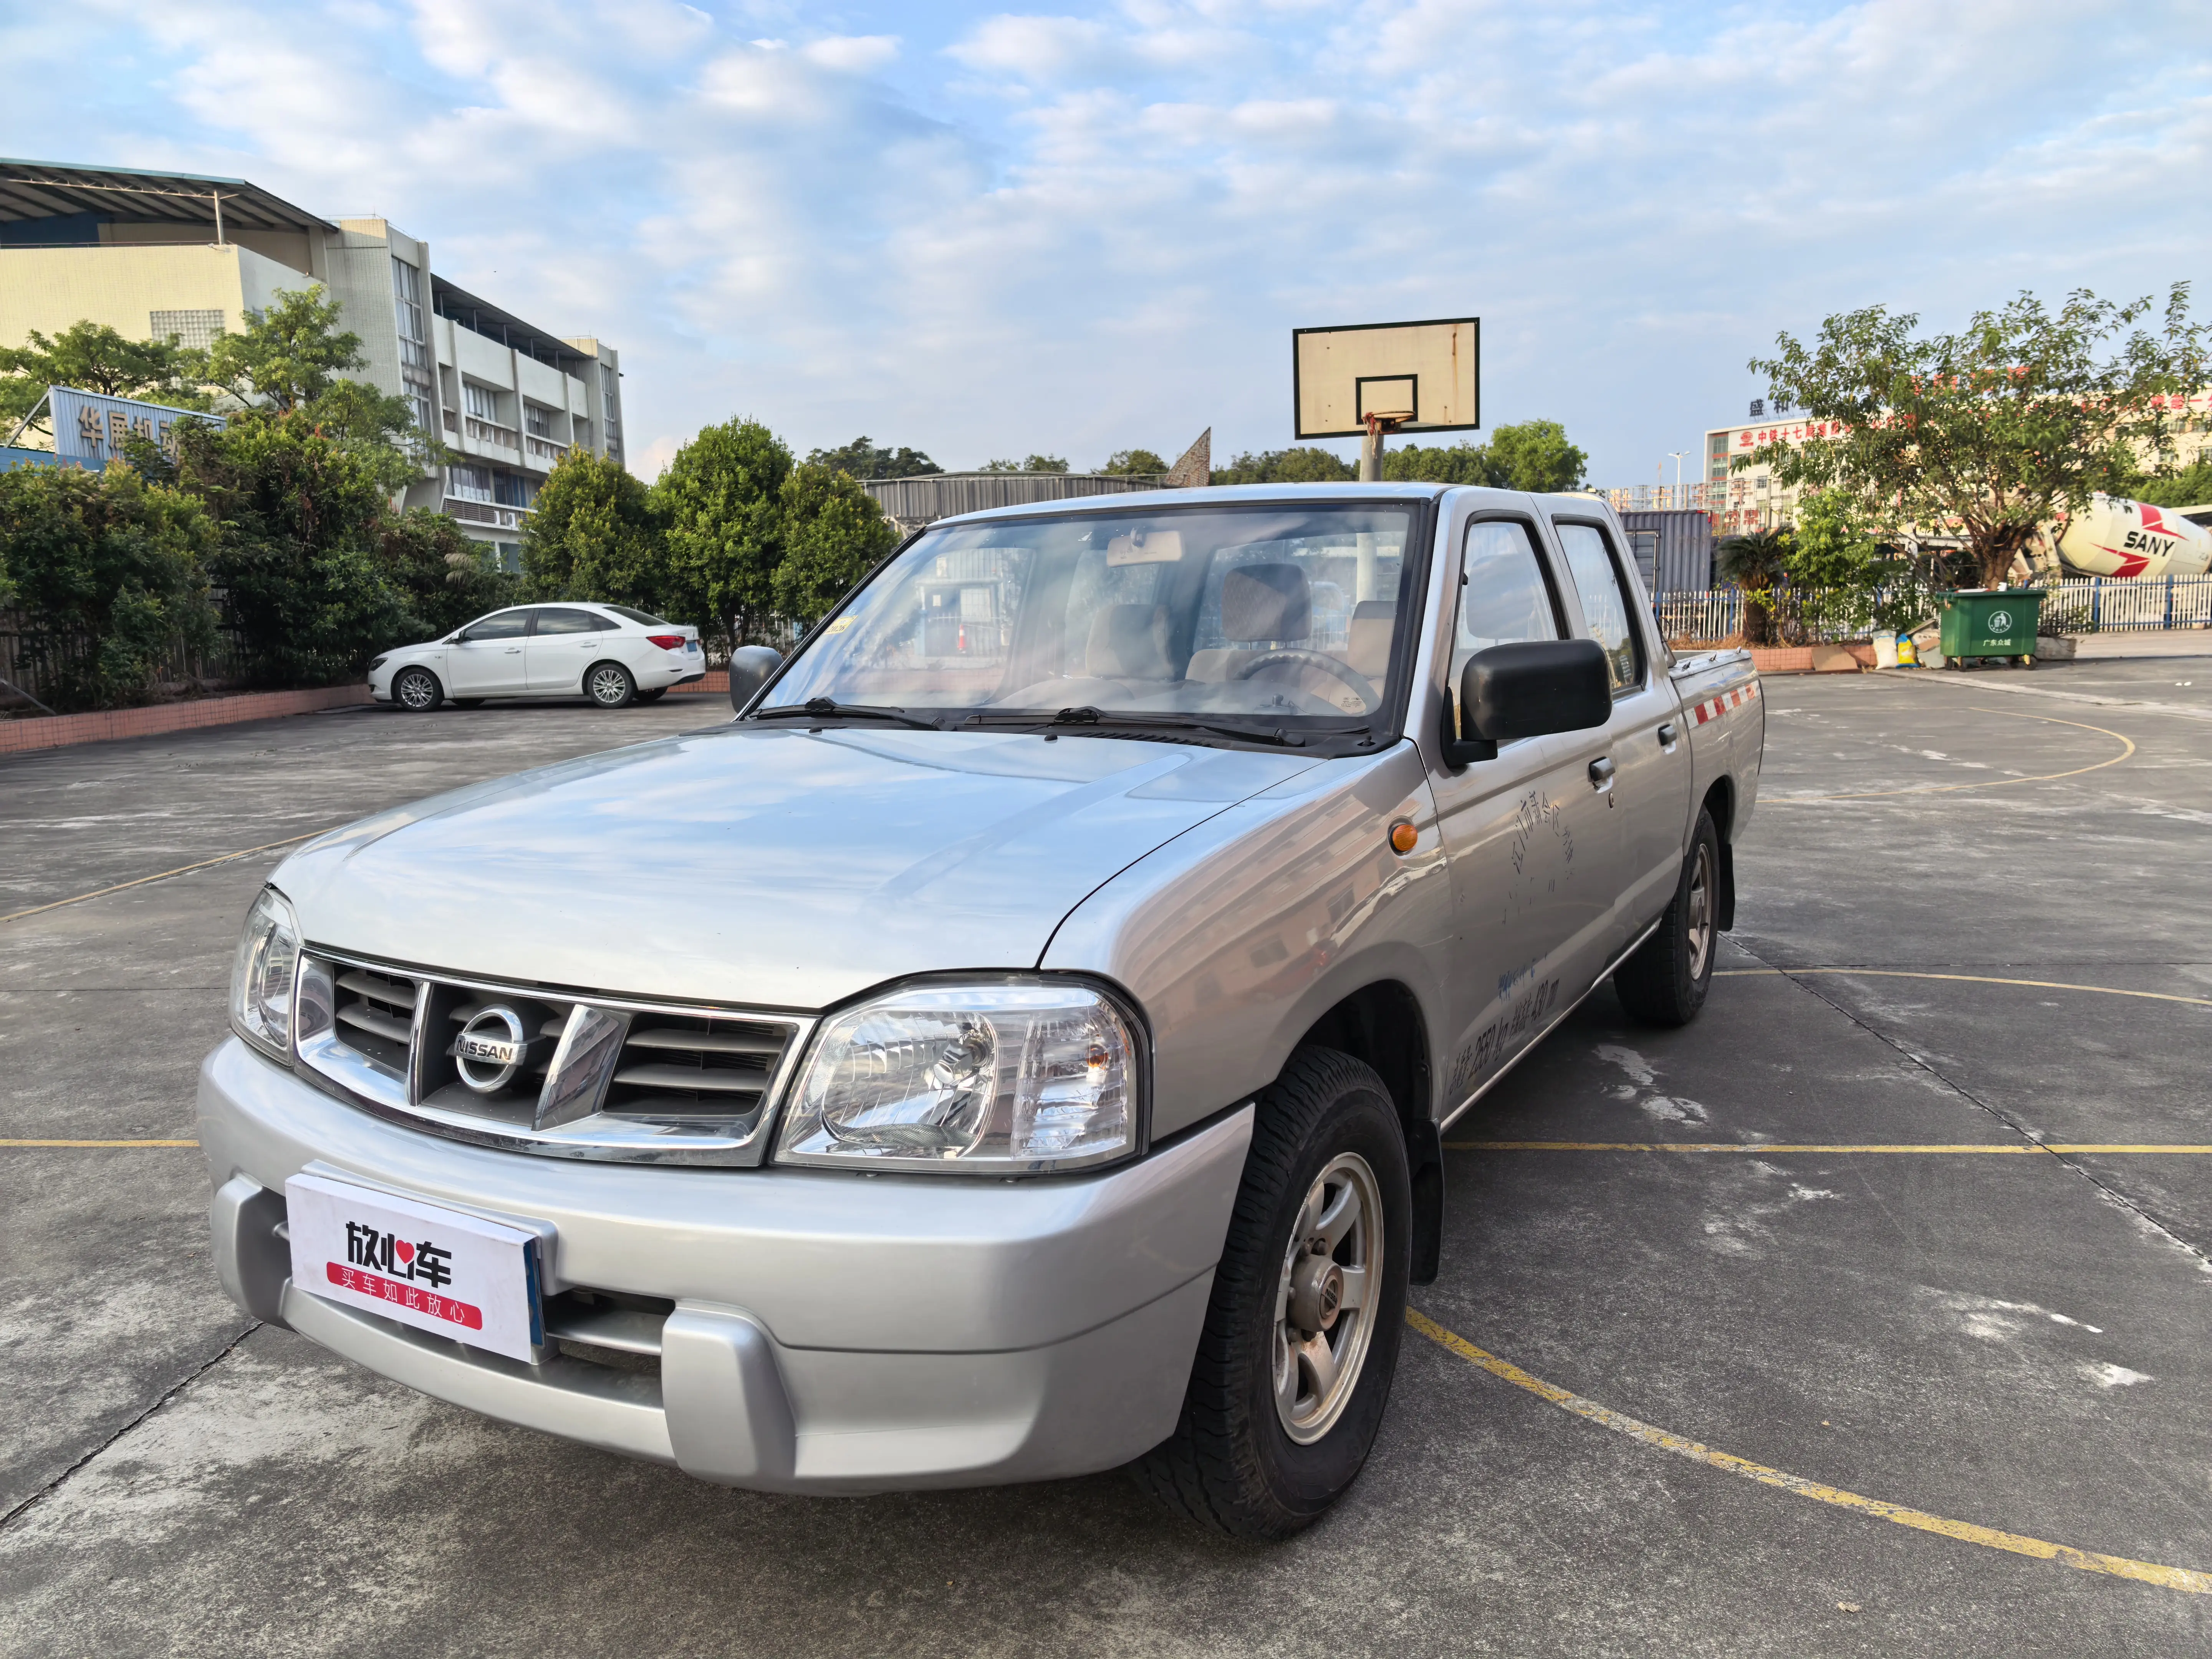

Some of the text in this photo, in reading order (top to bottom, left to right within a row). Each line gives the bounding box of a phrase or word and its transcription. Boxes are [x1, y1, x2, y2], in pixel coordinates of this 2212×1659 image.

[2123, 531, 2175, 557] SANY
[456, 1039, 513, 1060] NISSAN
[346, 1221, 452, 1288] 放心车
[341, 1268, 465, 1323] 买车如此放心
